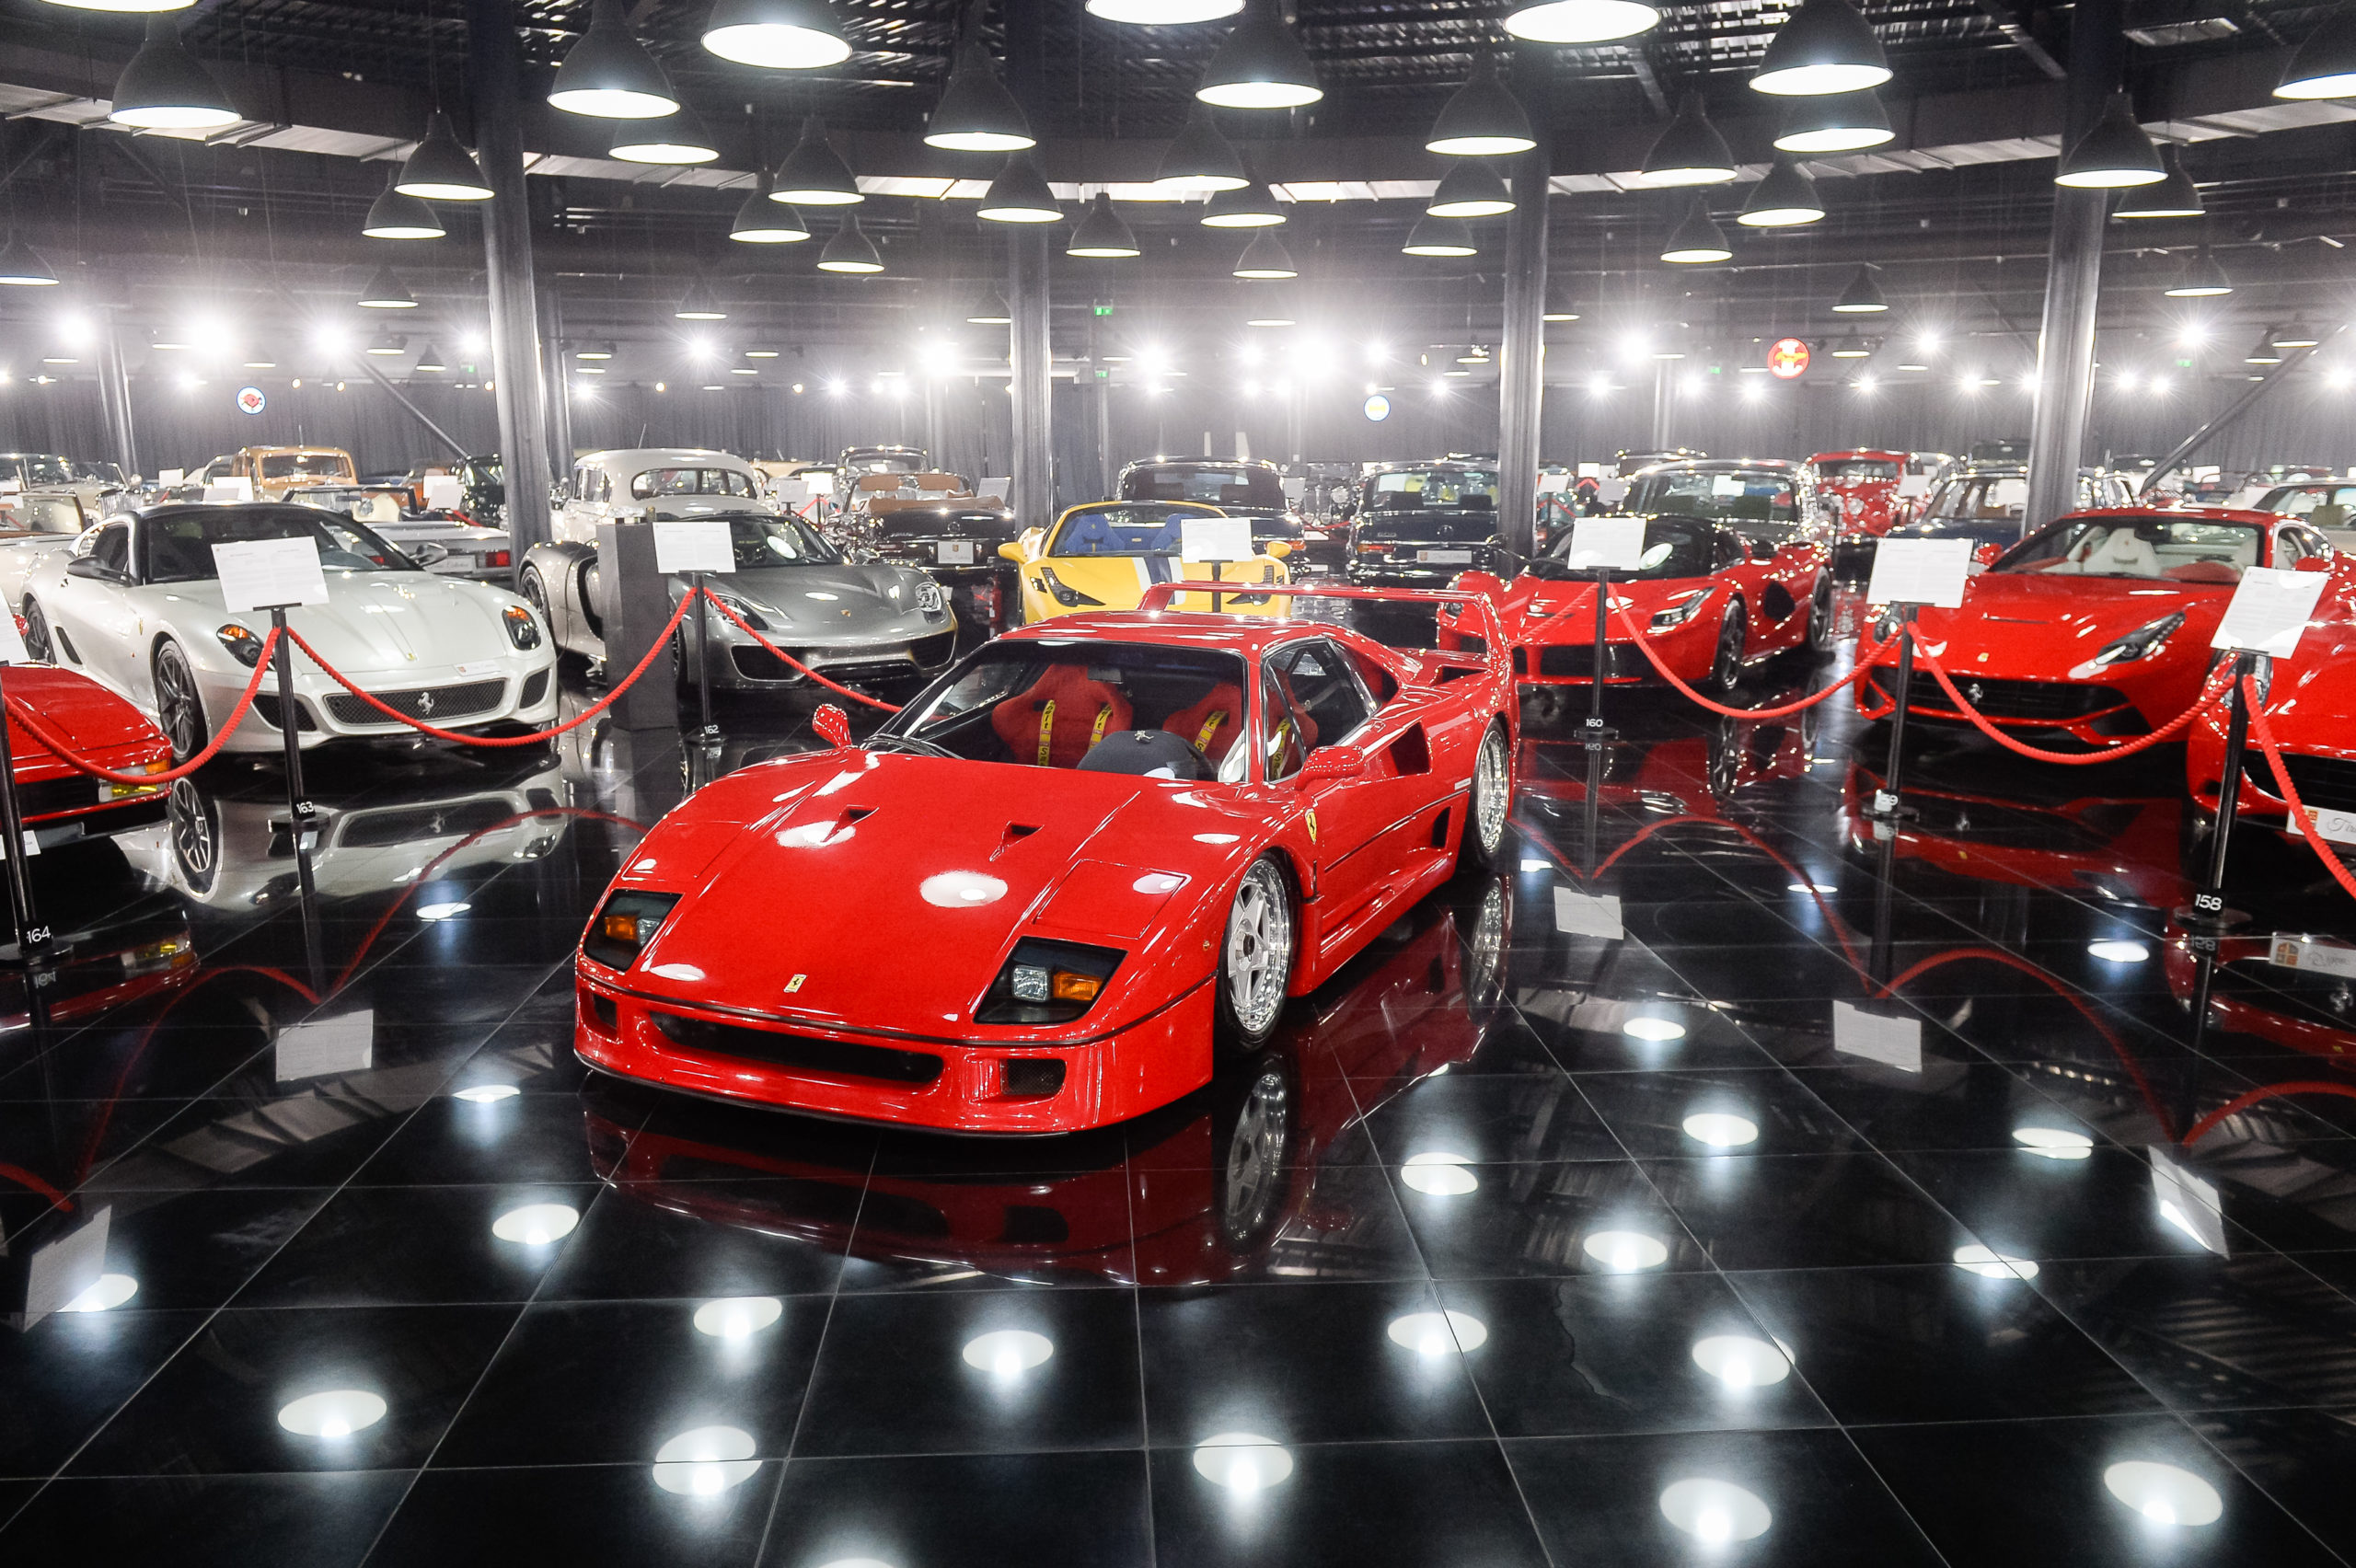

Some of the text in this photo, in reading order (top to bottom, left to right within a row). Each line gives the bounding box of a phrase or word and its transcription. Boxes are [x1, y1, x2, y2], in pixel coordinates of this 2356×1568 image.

[704, 724, 720, 734] 162
[1586, 719, 1603, 727] 160
[296, 801, 314, 814] 163
[2194, 894, 2223, 911] 158
[27, 925, 52, 944] 164
